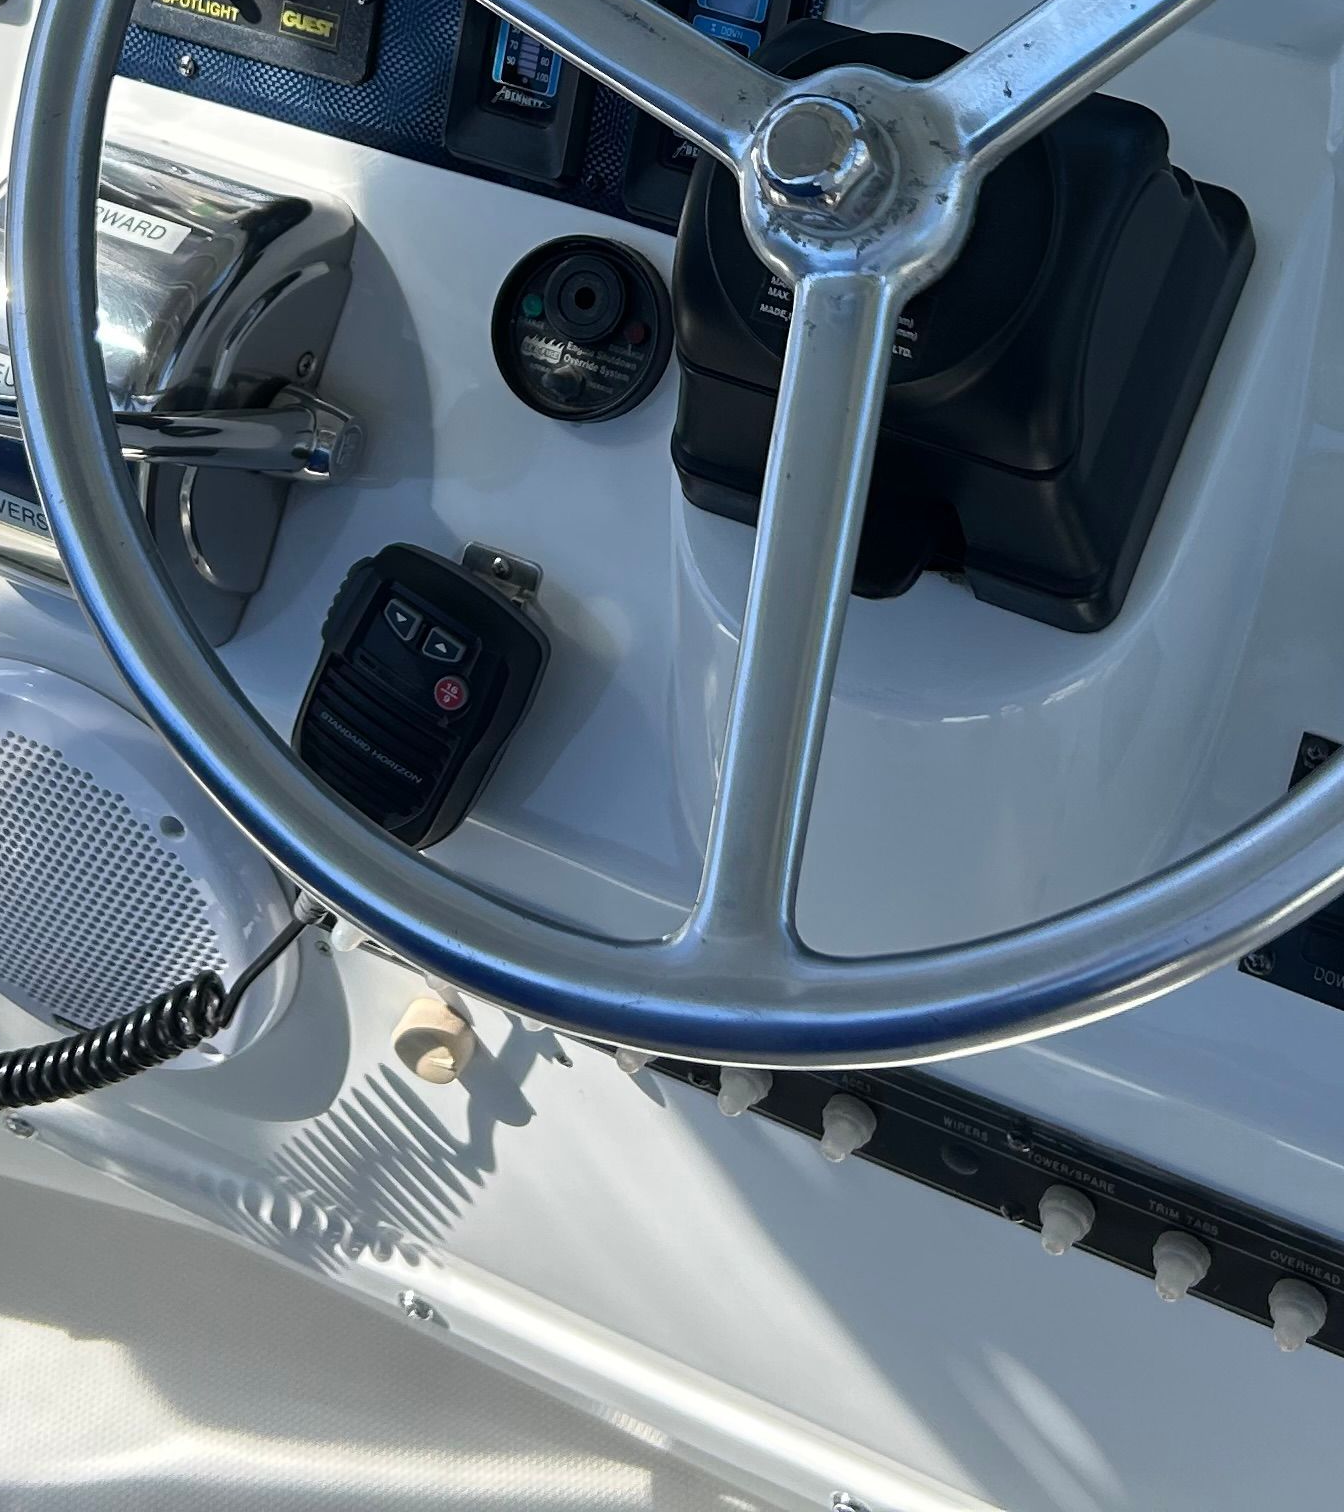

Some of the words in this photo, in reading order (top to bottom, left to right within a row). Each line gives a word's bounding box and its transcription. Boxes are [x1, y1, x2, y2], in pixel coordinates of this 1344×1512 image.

[282, 10, 334, 37] GUEST
[721, 26, 743, 39] DOWN
[564, 354, 599, 372] Override
[600, 365, 629, 382] System
[443, 695, 451, 703] 9
[448, 684, 457, 693] 16
[320, 712, 370, 751] STANDARD
[372, 750, 422, 784] HORIZON
[943, 1116, 988, 1142] WIPERS
[1027, 1151, 1115, 1194] TOWER/SPARE
[1148, 1200, 1179, 1219] TRIM
[1186, 1215, 1218, 1235] TABS
[1270, 1250, 1341, 1285] OVERHEAD
